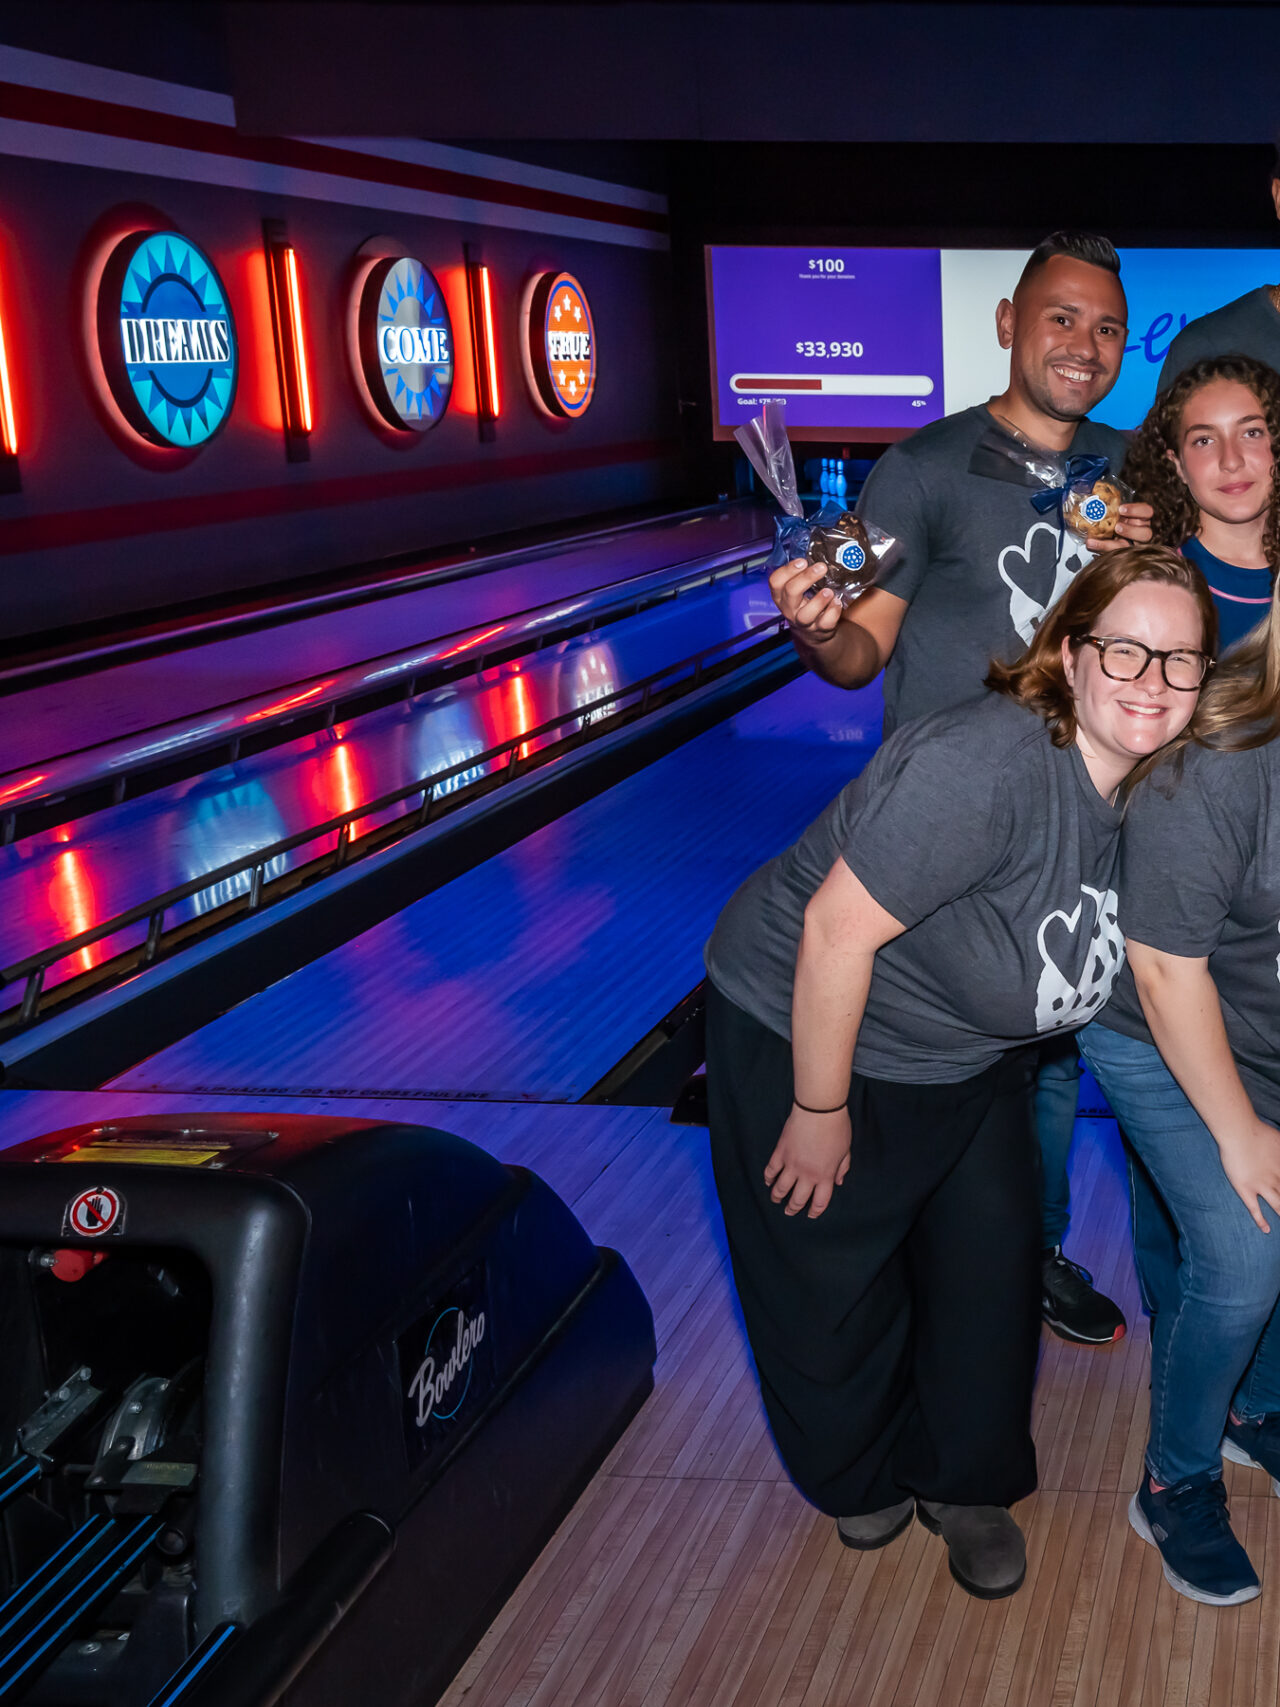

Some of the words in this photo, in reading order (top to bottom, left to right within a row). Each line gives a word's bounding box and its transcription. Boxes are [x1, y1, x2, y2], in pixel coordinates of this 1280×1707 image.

[808, 259, 845, 272] $100
[121, 318, 231, 363] DREAMS
[379, 326, 450, 364] COME
[548, 331, 592, 361] TRUE
[796, 341, 864, 358] $33,930
[737, 398, 758, 406] Goal:
[911, 400, 926, 408] 45%
[408, 1310, 485, 1427] Bowlero
